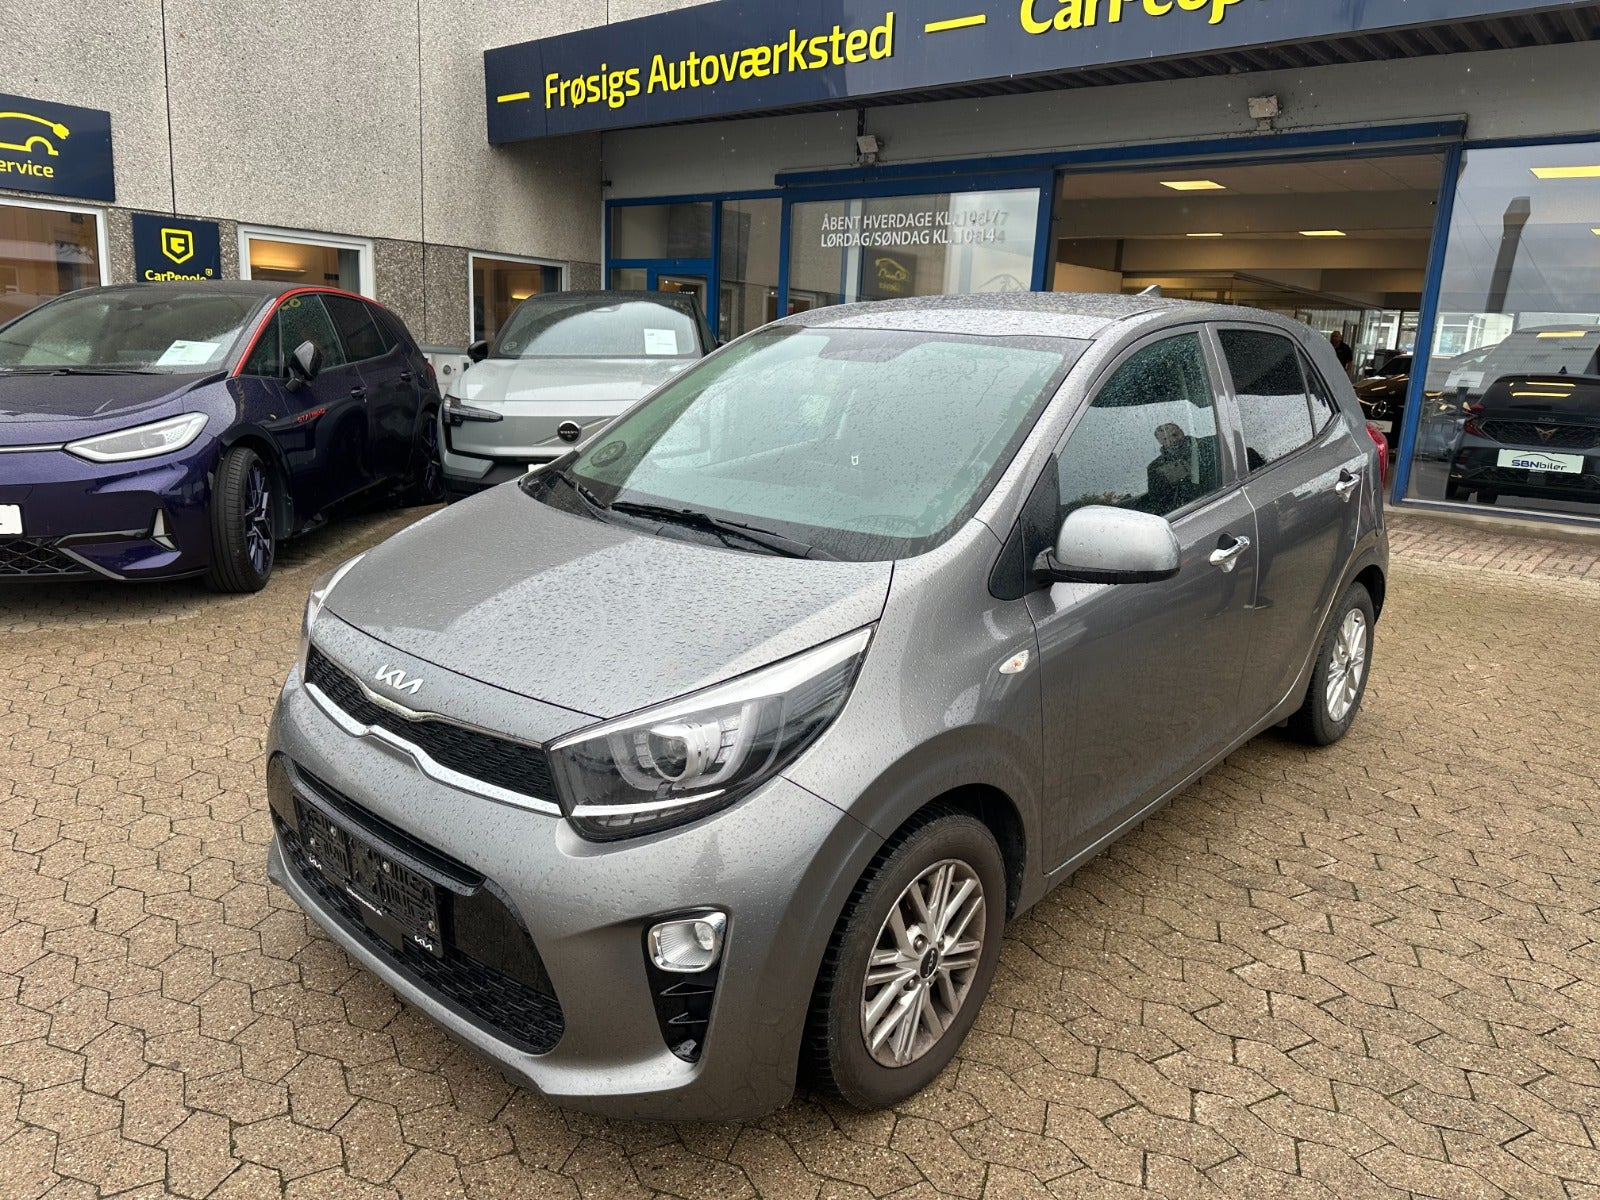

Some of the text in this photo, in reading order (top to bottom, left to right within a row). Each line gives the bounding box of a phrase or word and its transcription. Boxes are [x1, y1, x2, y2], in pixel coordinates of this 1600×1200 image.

[545, 63, 640, 109] Frøsigs
[647, 11, 894, 94] Autoværksted
[821, 213, 861, 231] ÅBENT
[863, 212, 932, 229] HVERDAGE
[935, 211, 955, 226] KL.
[820, 230, 930, 247] LØRDAG/SØNDAG
[932, 229, 953, 244] KL.
[1511, 459, 1567, 471] SBNbiler
